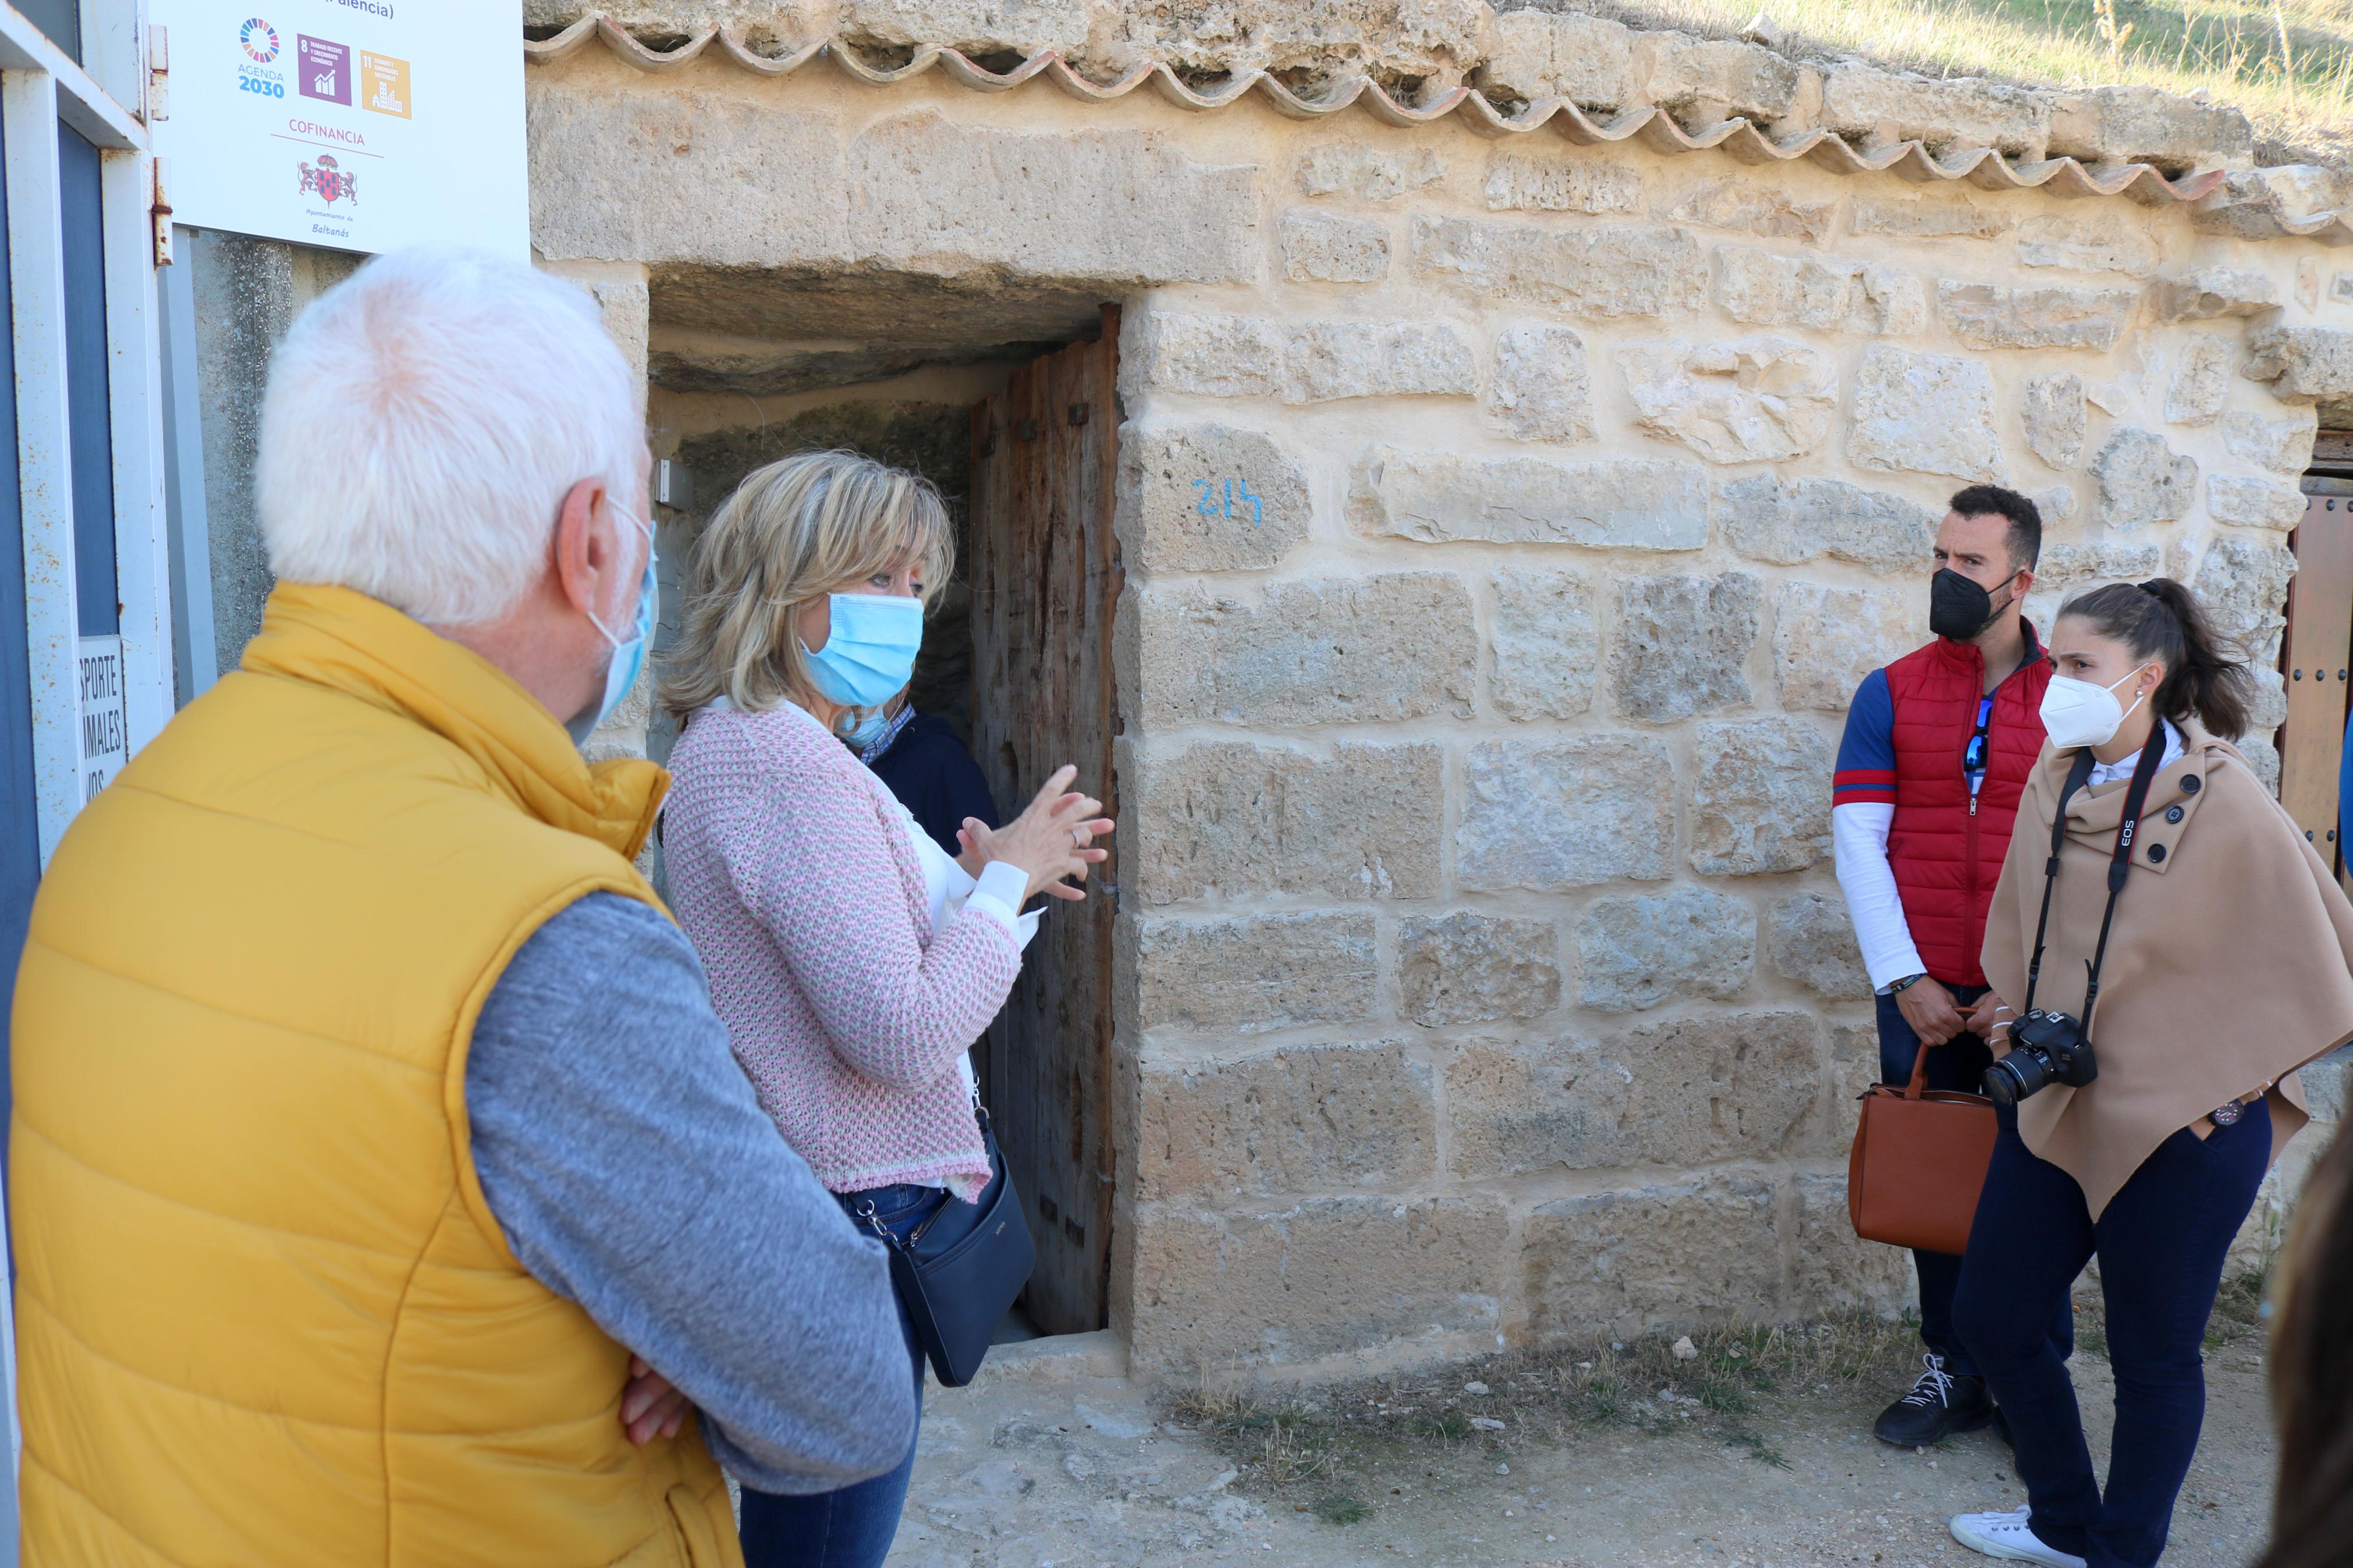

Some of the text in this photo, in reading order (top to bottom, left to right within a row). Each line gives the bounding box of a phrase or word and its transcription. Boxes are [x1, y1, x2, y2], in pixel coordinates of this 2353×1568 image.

[301, 39, 308, 53] 8
[310, 41, 343, 55] TRABAJO DECENTE
[363, 55, 371, 69] 11
[238, 64, 284, 82] AGENDA
[239, 75, 285, 99] 2030
[289, 119, 365, 145] COFINANCIA
[306, 208, 345, 221] Ayuntamiento
[312, 223, 349, 237] Baltanás
[83, 709, 120, 759] IMALES
[2121, 820, 2134, 847] EOS
